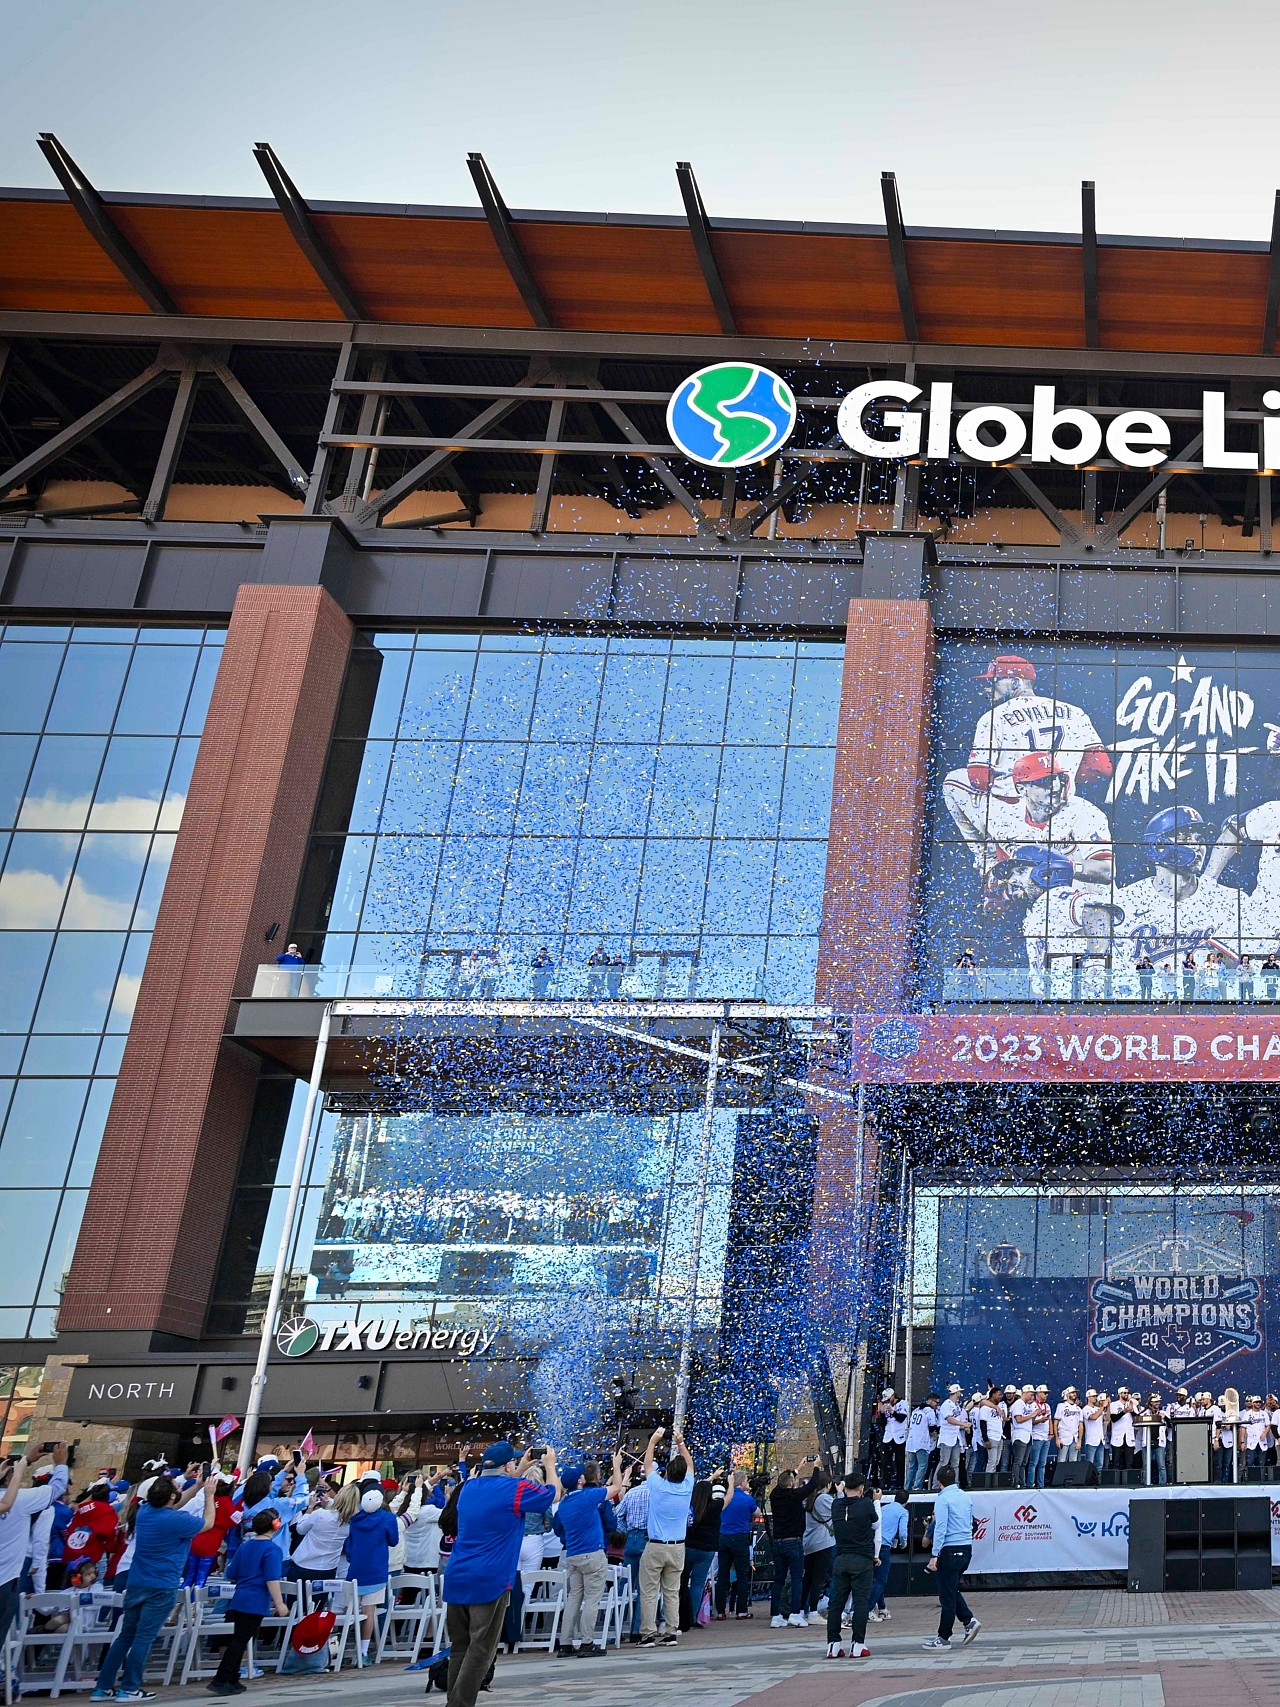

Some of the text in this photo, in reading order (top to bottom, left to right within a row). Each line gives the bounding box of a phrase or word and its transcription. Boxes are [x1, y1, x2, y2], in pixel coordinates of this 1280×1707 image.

[837, 380, 1171, 468] Globe
[1003, 704, 1071, 727] EOVALDI
[1116, 675, 1254, 737] GO AND
[1025, 725, 1064, 755] 17
[1105, 734, 1259, 804] TAKE IT
[952, 1034, 1042, 1062] 2023
[1057, 1034, 1198, 1062] WORLD
[1134, 1275, 1219, 1300] WORLD
[1102, 1304, 1253, 1332] CHAMPIONS
[1141, 1333, 1211, 1346] 20 23
[88, 1382, 175, 1400] NORTH
[911, 1414, 923, 1426] 90
[465, 1442, 489, 1450] ERIES
